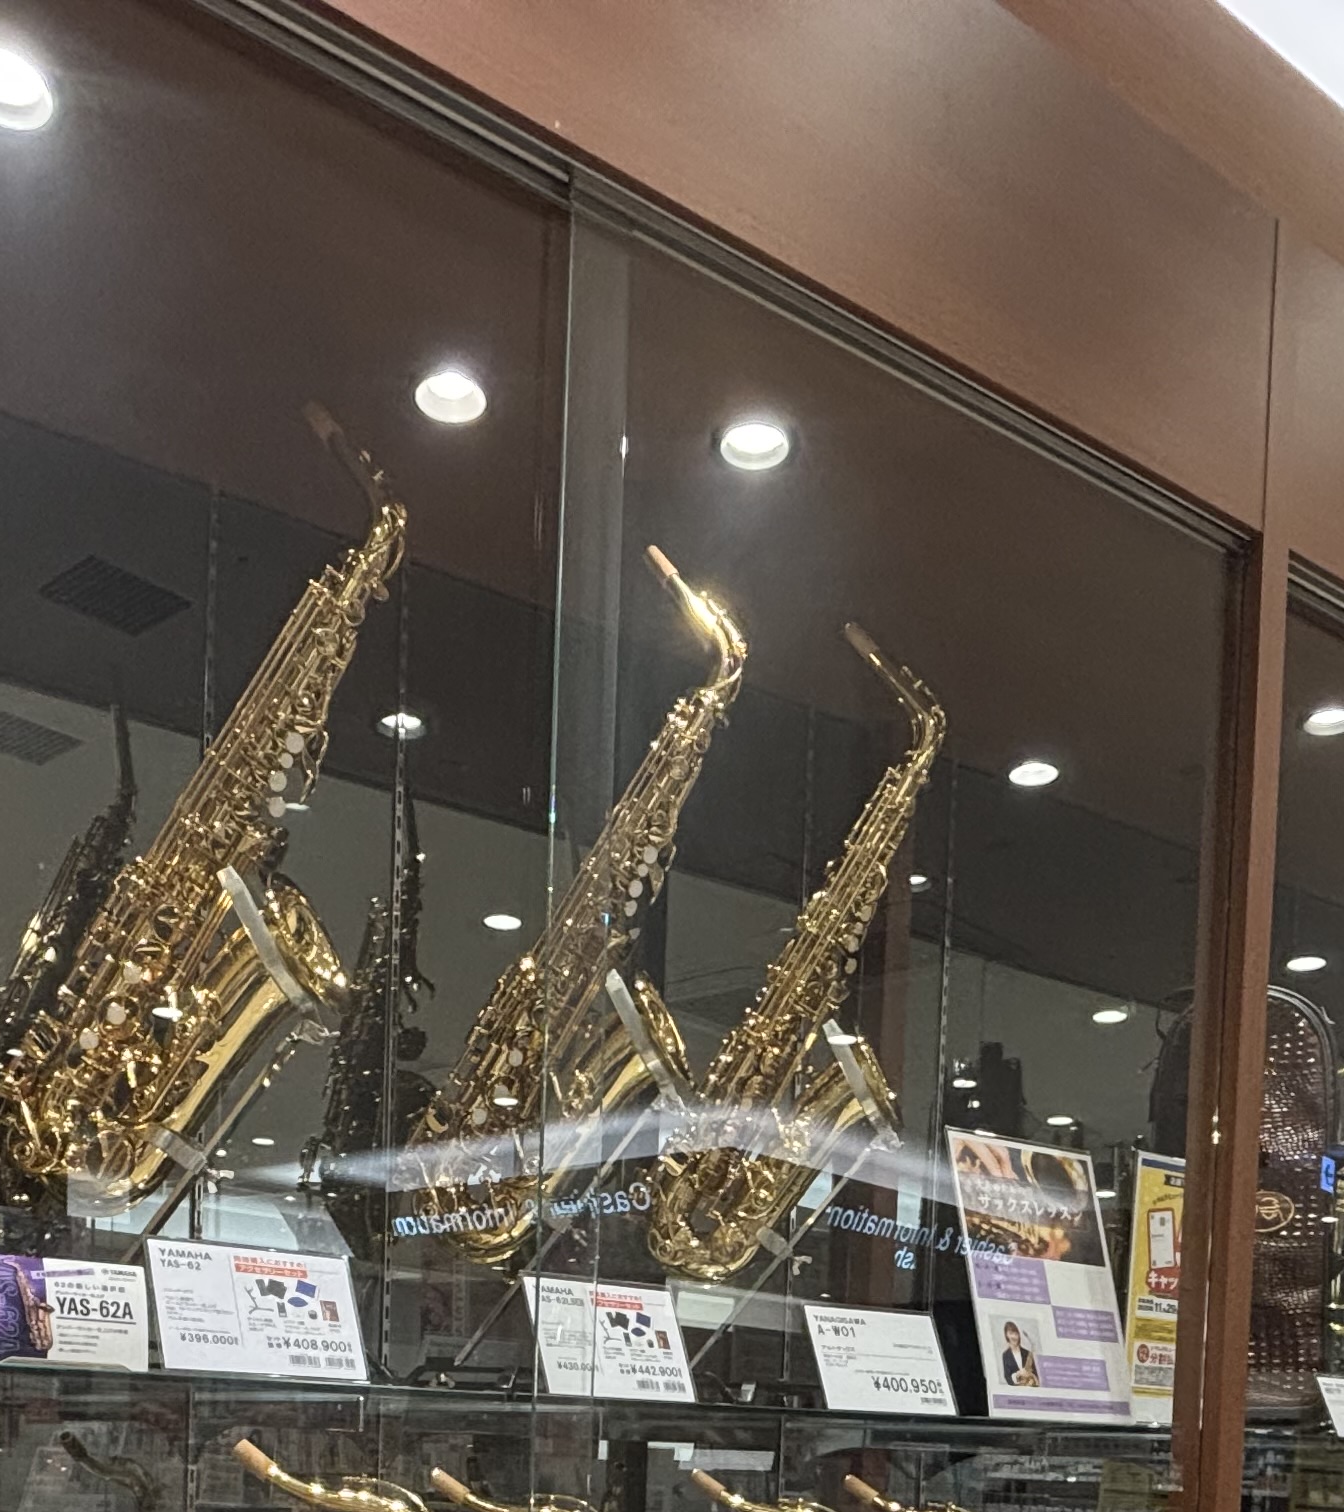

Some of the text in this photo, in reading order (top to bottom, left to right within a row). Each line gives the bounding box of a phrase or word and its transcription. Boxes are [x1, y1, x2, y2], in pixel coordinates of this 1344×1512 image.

[158, 1247, 212, 1261] YAMAHA
[160, 1258, 202, 1271] YAS-62
[56, 1296, 134, 1320] YAS-62A
[817, 1324, 856, 1338] A-W01
